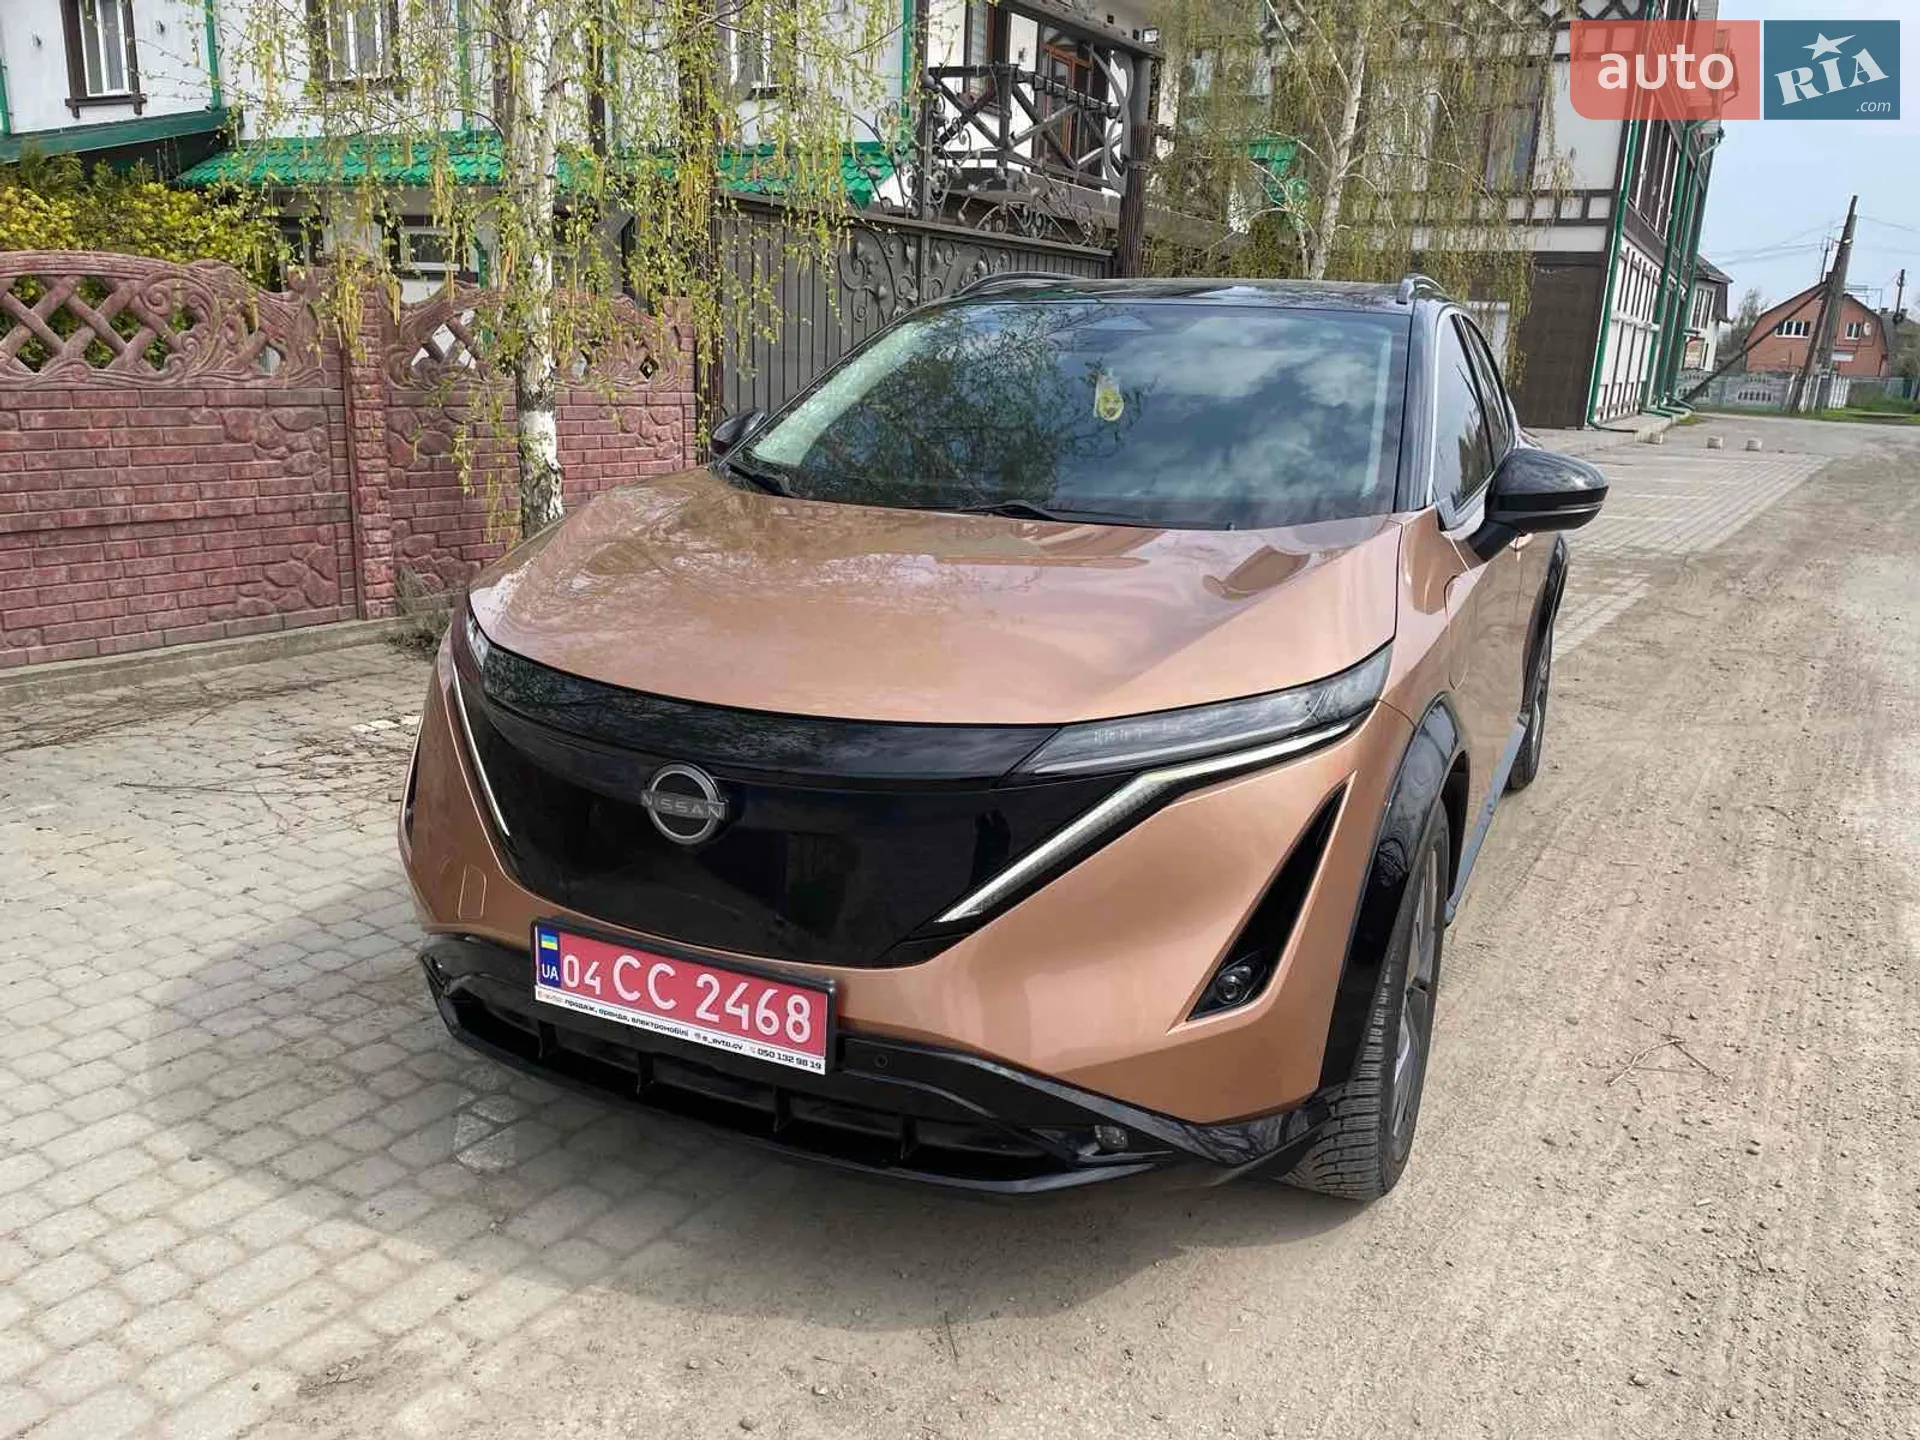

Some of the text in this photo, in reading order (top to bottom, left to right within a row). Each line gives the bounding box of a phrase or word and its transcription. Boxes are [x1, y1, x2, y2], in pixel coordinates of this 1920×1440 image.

[541, 963, 559, 981] UA
[563, 954, 812, 1044] 04 CC 2468
